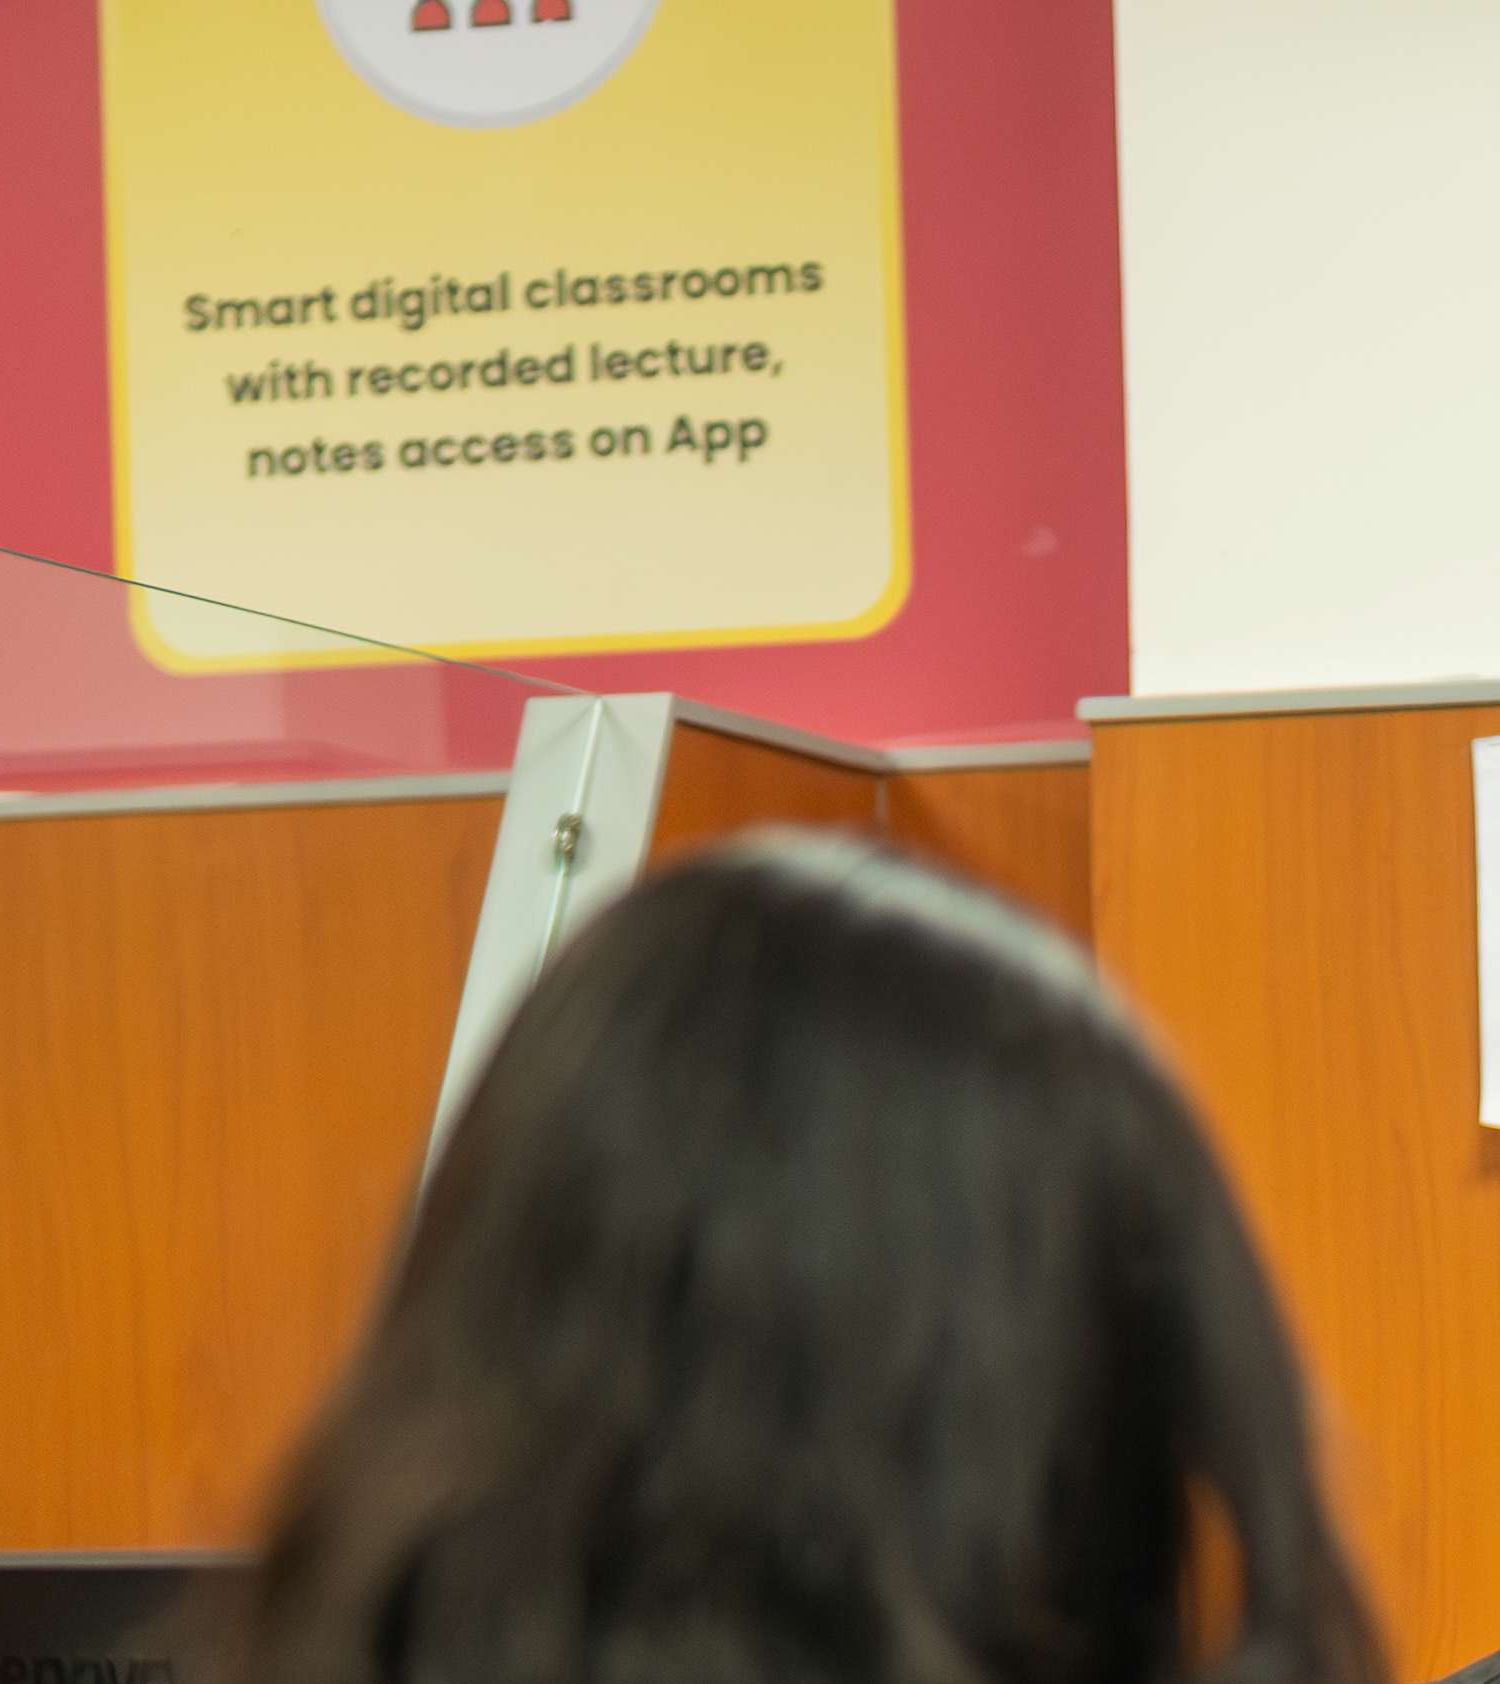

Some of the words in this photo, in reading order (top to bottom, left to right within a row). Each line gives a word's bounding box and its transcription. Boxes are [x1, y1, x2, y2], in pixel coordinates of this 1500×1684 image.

[184, 286, 337, 332] Smart
[349, 271, 510, 331] digital
[523, 259, 825, 311] classrooms
[225, 359, 333, 404] with
[346, 345, 575, 397] recorded
[589, 338, 784, 384] lecture,
[247, 435, 385, 480] notes
[397, 425, 576, 469] access
[587, 420, 652, 458] on
[665, 412, 769, 464] App
